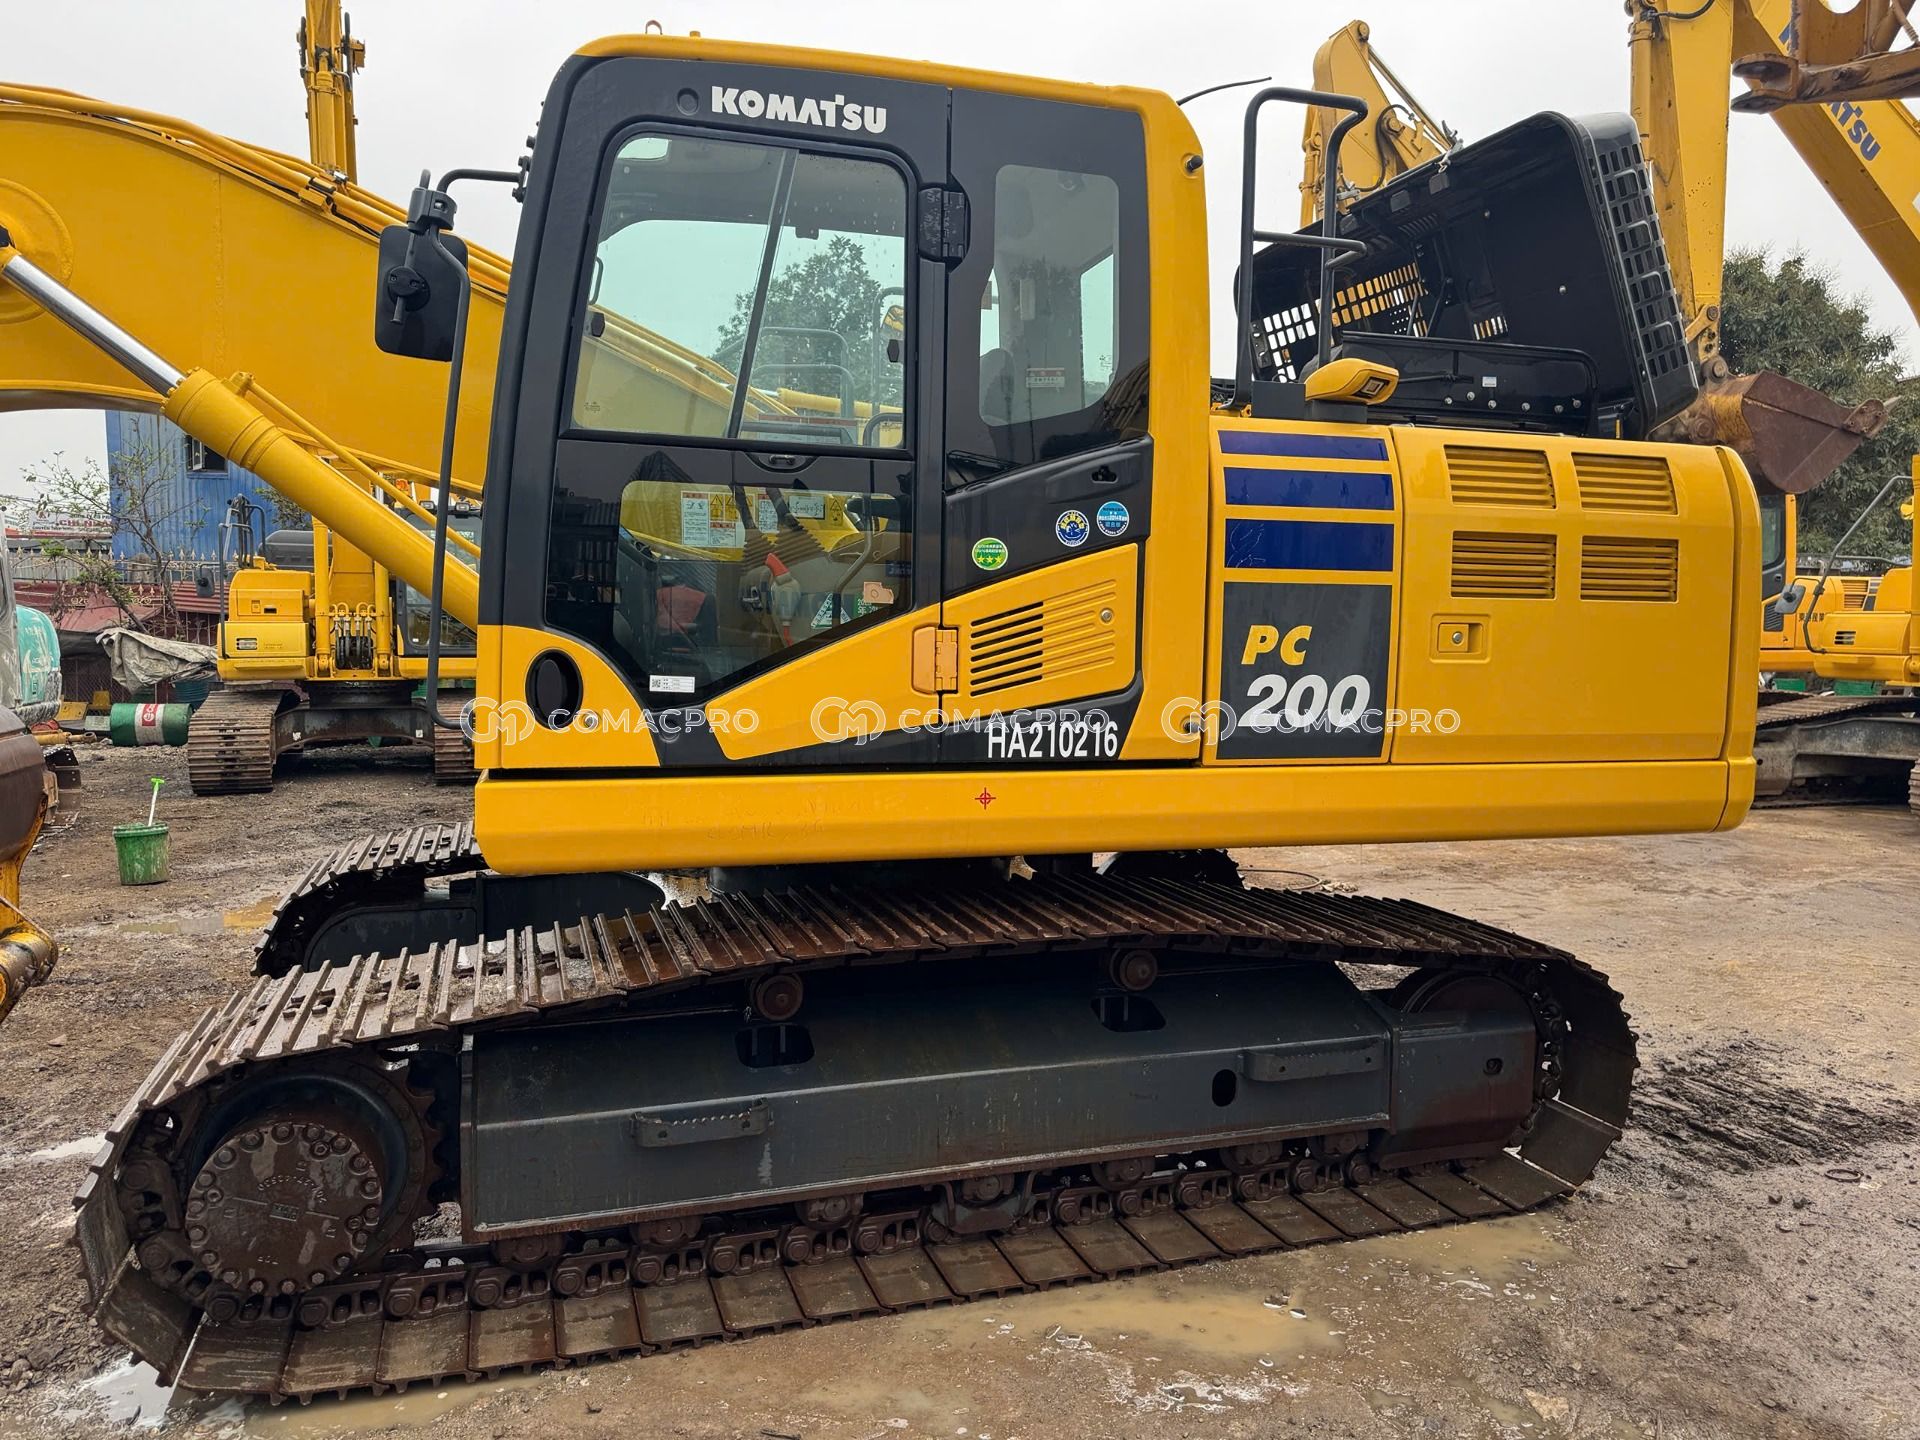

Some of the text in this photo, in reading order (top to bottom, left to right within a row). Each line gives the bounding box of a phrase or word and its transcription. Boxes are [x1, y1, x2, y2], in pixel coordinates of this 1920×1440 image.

[711, 85, 887, 133] KOMATSU
[1241, 625, 1313, 666] PC
[1237, 674, 1370, 728] 200
[987, 720, 1118, 758] HA210216
